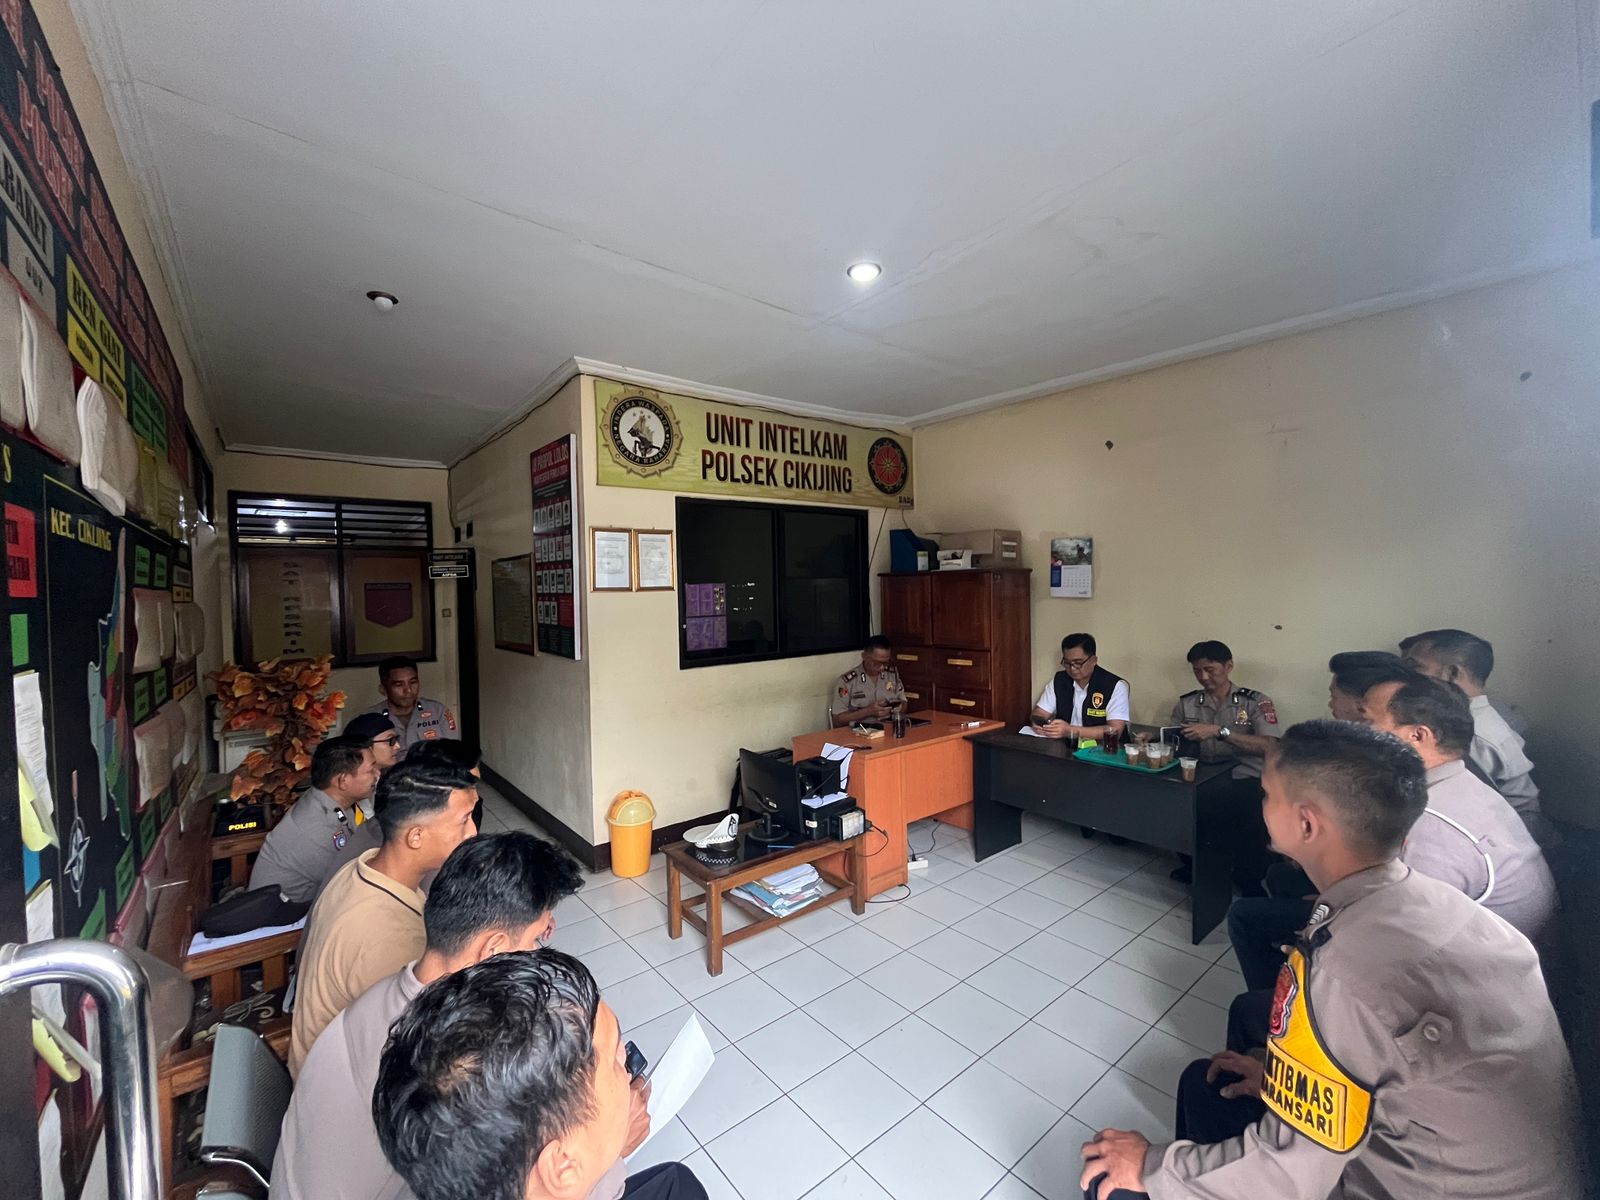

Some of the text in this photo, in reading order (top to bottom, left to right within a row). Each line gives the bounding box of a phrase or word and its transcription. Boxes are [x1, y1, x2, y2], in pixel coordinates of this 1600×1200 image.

[706, 411, 847, 460] UNIT INTELKAM
[702, 449, 852, 493] POLSEK CIKIJING
[50, 506, 75, 539] KEC.
[228, 820, 257, 831] POLISI
